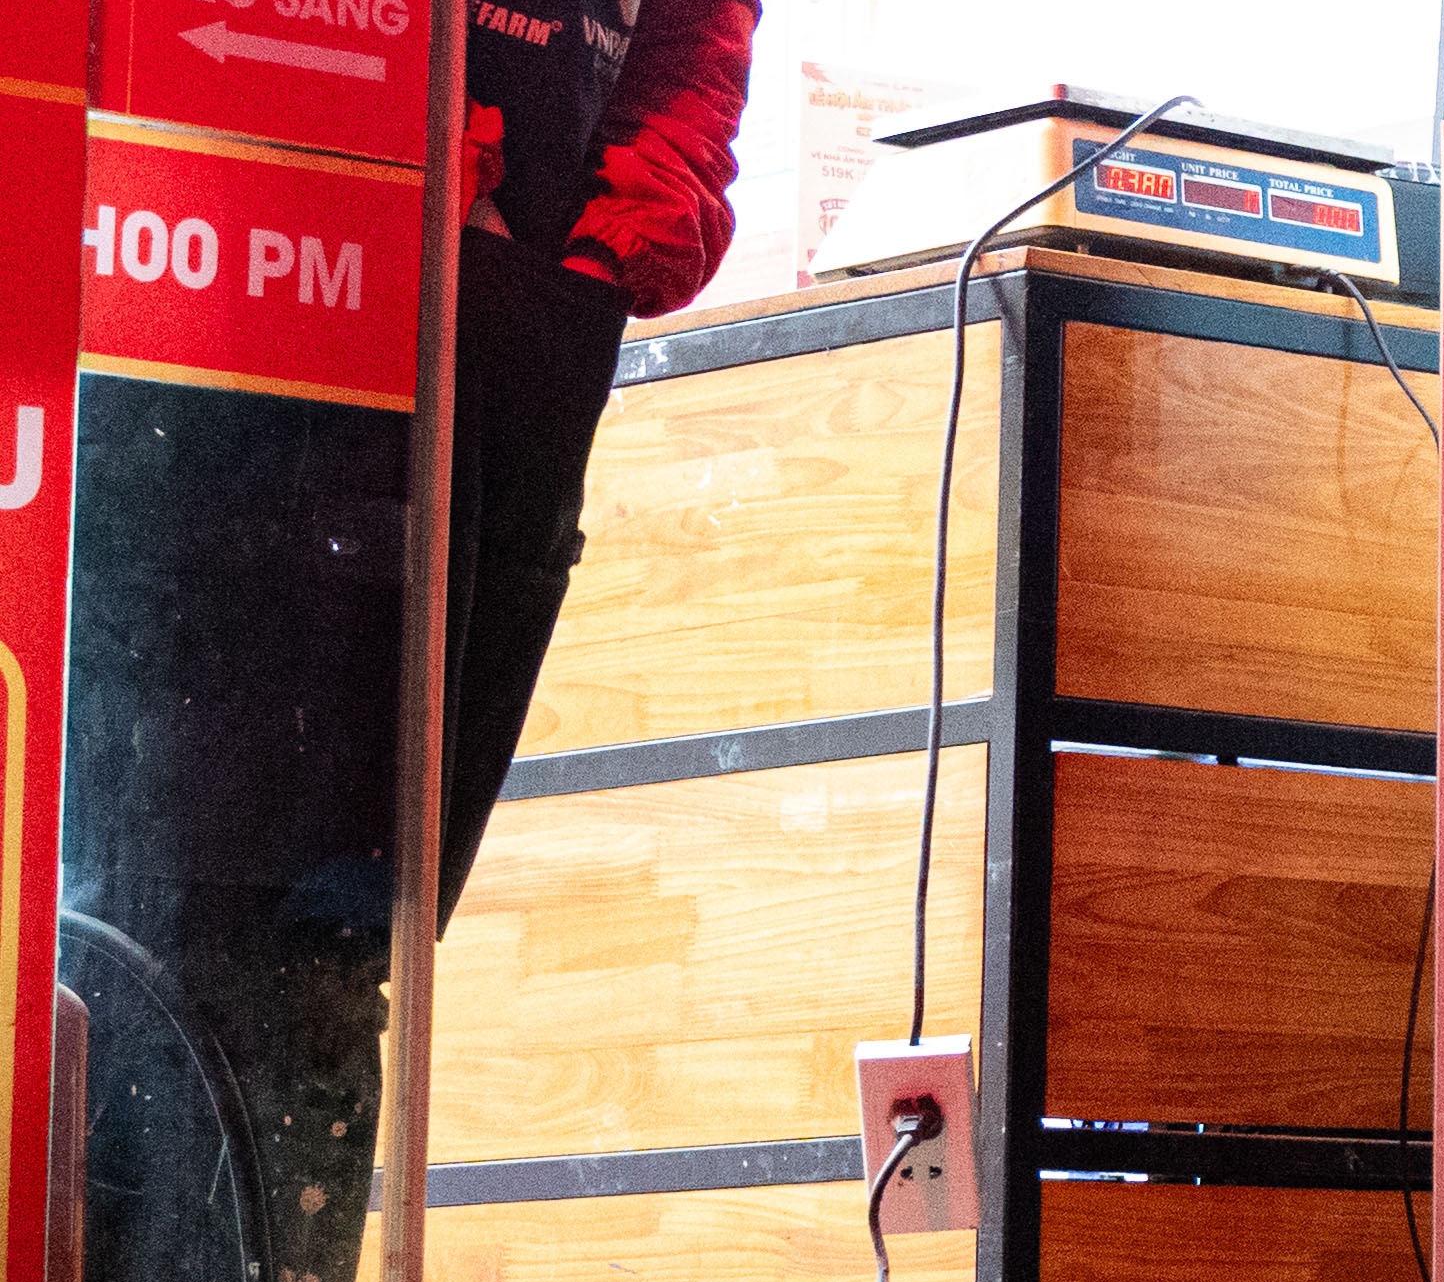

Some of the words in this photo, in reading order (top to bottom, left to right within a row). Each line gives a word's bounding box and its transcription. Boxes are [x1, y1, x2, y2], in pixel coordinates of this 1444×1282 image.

[1181, 162, 1206, 175] UNIT
[1209, 166, 1240, 181] PRICE
[1269, 177, 1302, 193] TOTAL
[1304, 183, 1334, 198] PRICE
[246, 227, 364, 311] PM
